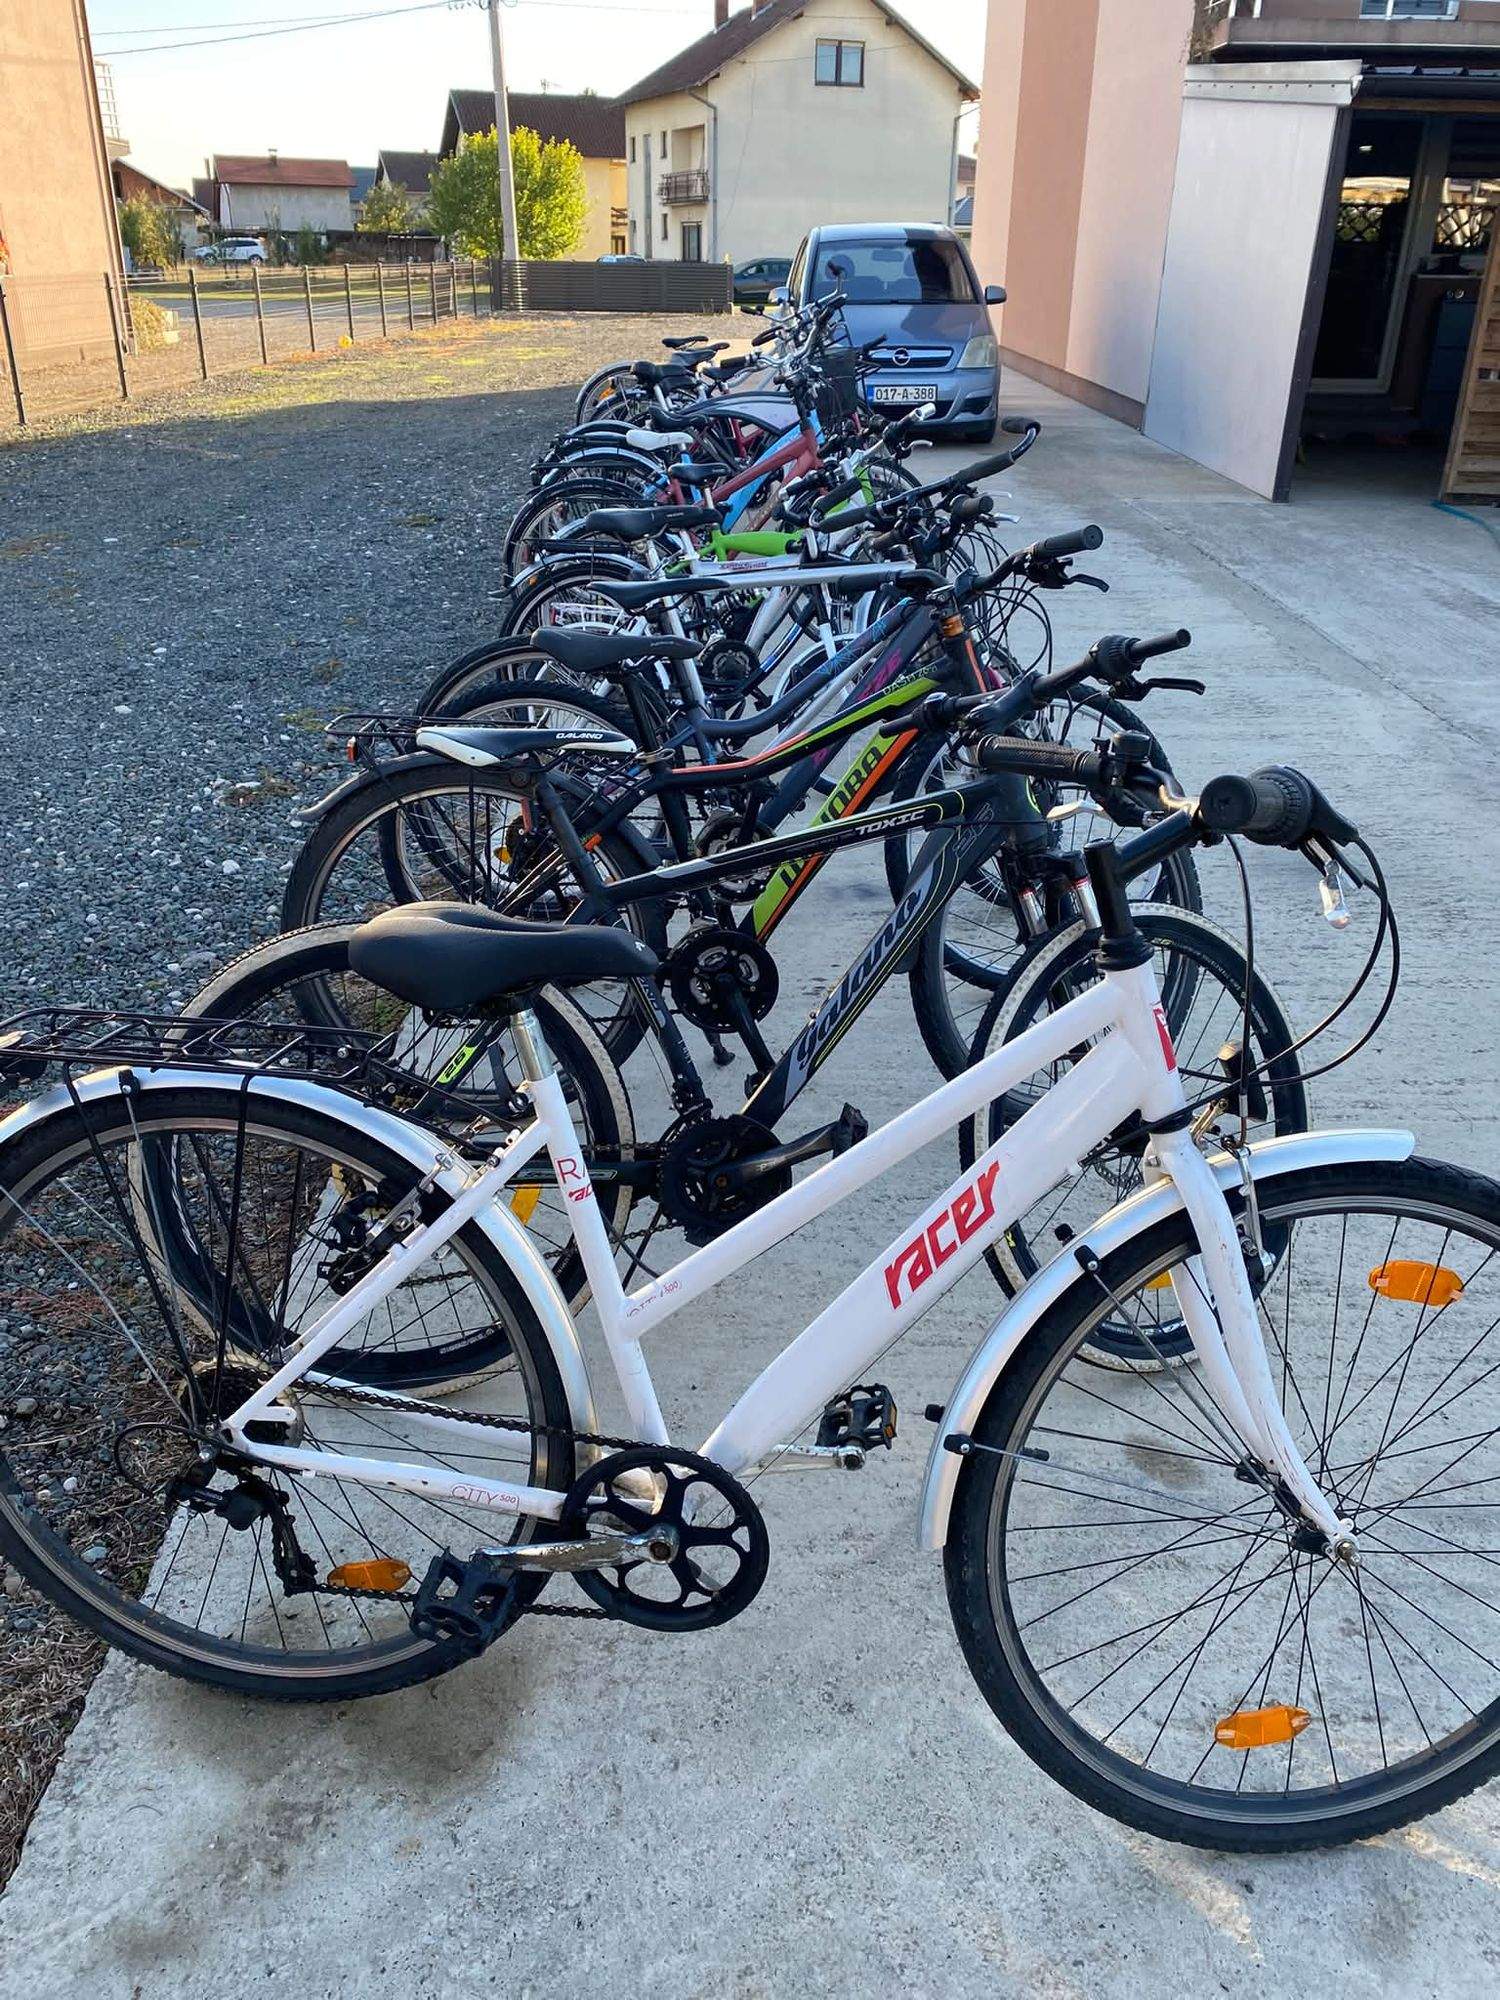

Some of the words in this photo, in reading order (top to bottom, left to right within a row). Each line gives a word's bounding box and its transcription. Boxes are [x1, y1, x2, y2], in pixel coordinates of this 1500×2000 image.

[876, 387, 934, 400] 017-A-388
[855, 809, 926, 836] TOXIC
[884, 1159, 1000, 1310] racer
[451, 1485, 498, 1505] CITY
[499, 1494, 517, 1504] 500
